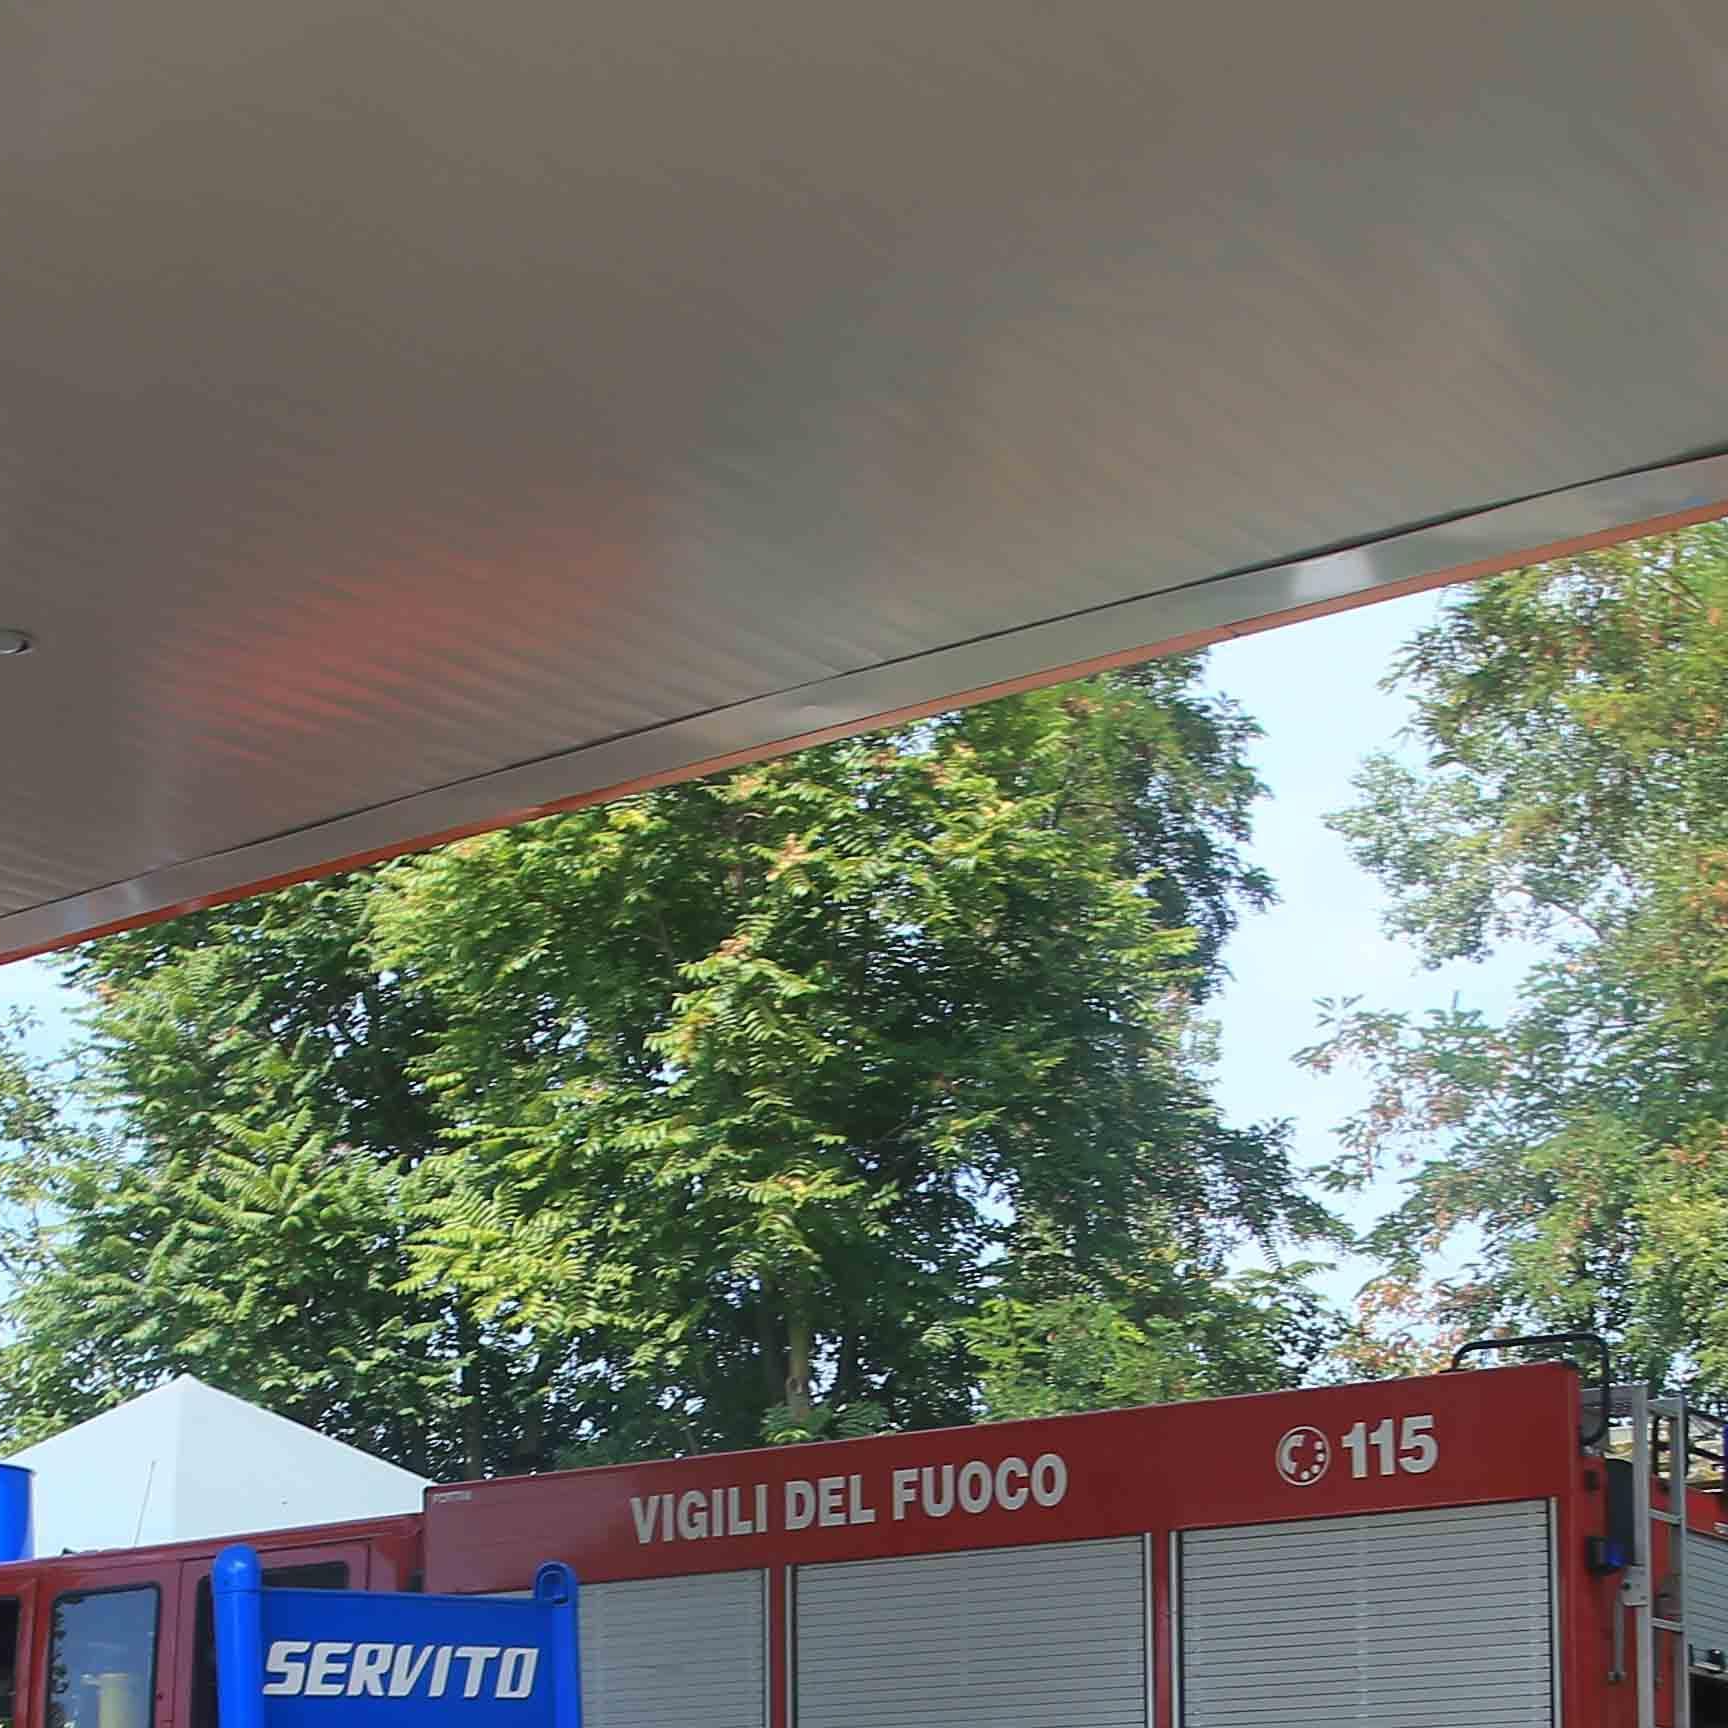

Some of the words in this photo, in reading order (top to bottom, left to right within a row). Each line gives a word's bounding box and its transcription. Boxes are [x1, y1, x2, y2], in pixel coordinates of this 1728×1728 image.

[1341, 1414, 1439, 1479] 115
[629, 1483, 769, 1545] VIGILI
[783, 1473, 876, 1532] DEL
[891, 1452, 1069, 1522] FUOCO
[261, 1640, 540, 1699] SERVITO
